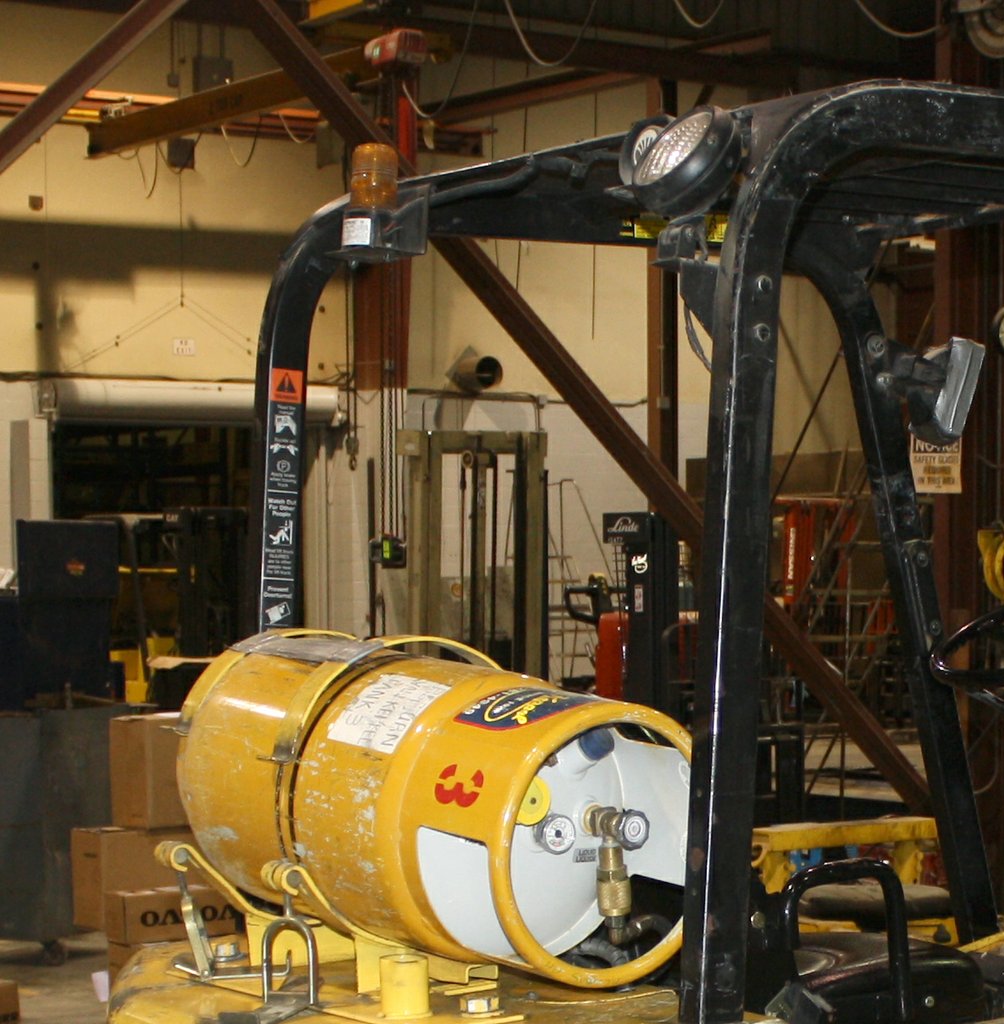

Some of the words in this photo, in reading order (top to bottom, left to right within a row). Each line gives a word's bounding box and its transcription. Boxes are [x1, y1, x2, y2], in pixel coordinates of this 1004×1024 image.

[913, 455, 937, 464] SAFETY
[607, 516, 639, 533] Linde
[140, 903, 236, 927] VOVO
